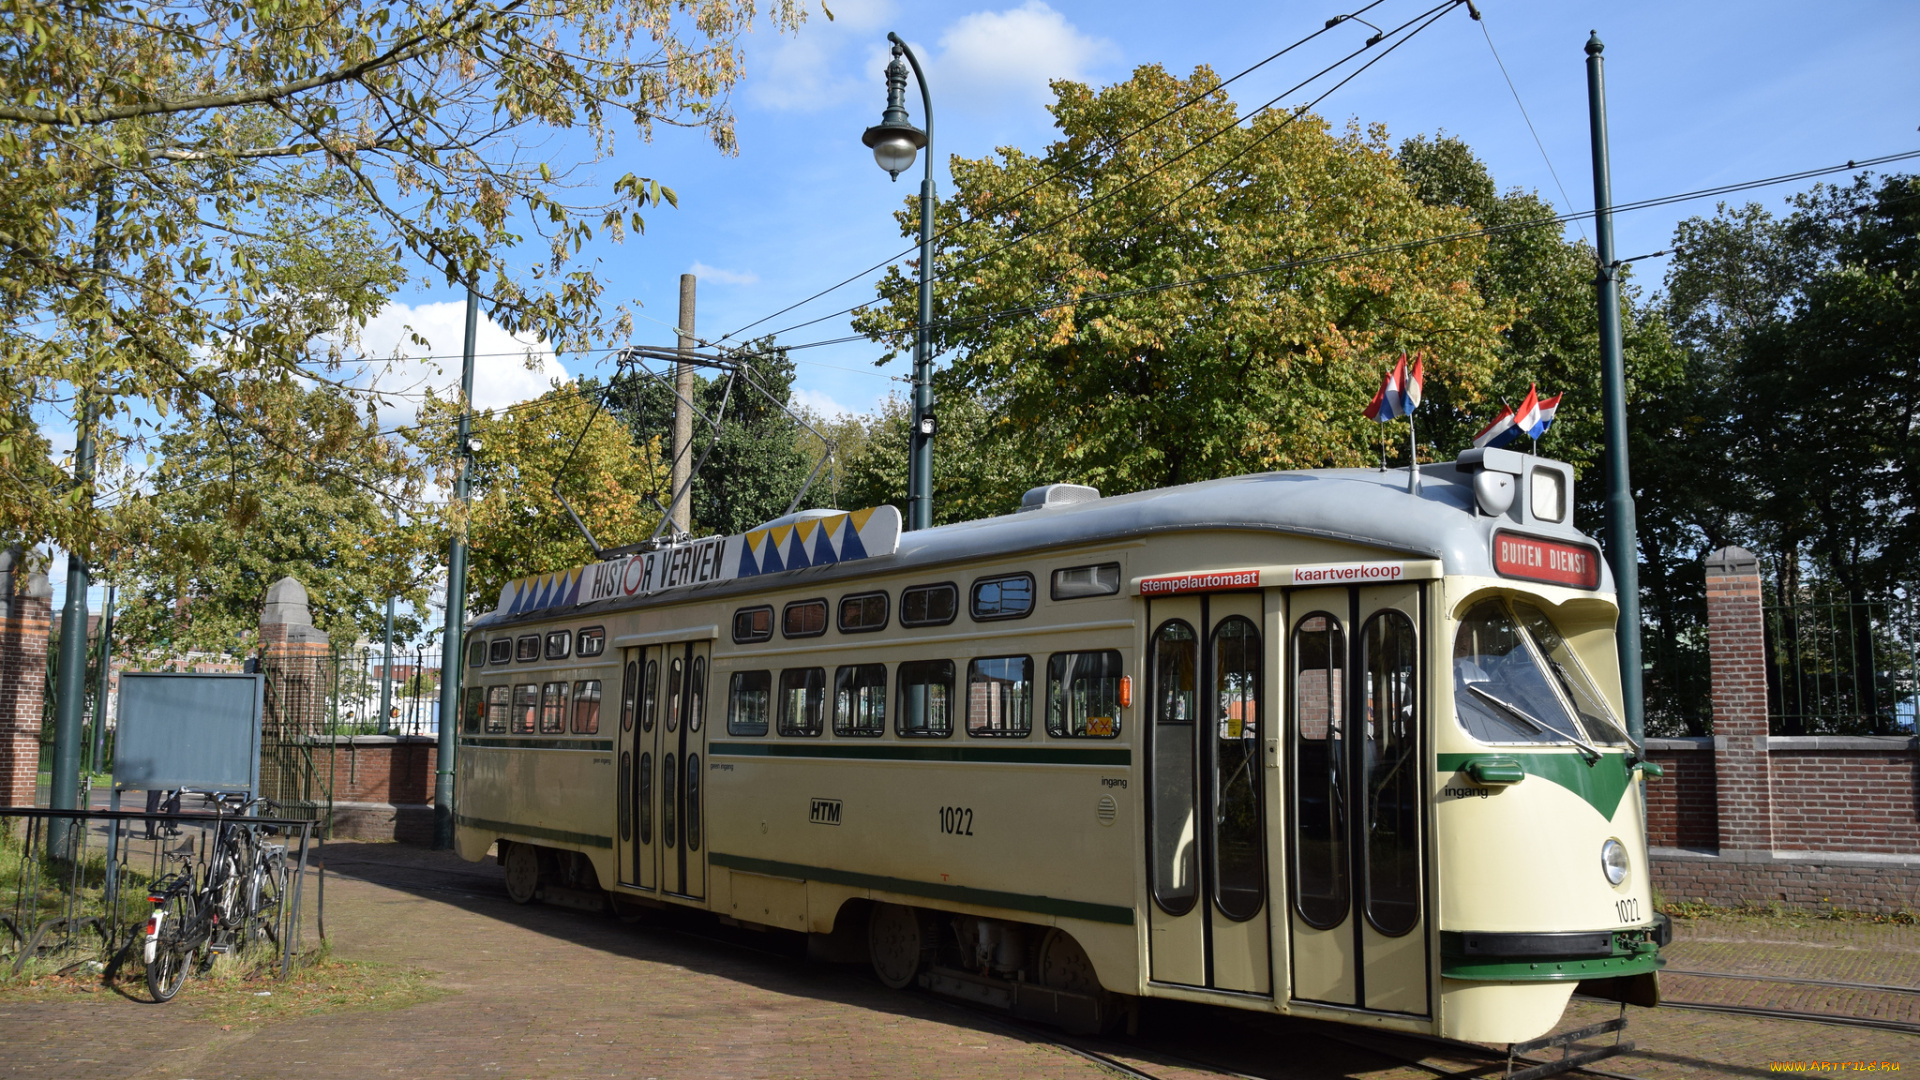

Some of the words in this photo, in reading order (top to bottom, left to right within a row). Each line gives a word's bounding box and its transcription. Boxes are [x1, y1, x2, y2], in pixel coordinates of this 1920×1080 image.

[1501, 541, 1542, 567] BUITEN
[1550, 549, 1586, 574] DIENST
[591, 554, 654, 599] HISTOR
[659, 540, 727, 587] VERVEN
[1294, 564, 1401, 583] kaartverkoop
[1141, 572, 1257, 593] stempelautomaat
[1101, 776, 1128, 789] ingang
[1444, 785, 1489, 799] ingang
[811, 801, 841, 822] HTM
[939, 806, 974, 836] 1022
[1615, 898, 1640, 923] 1022
